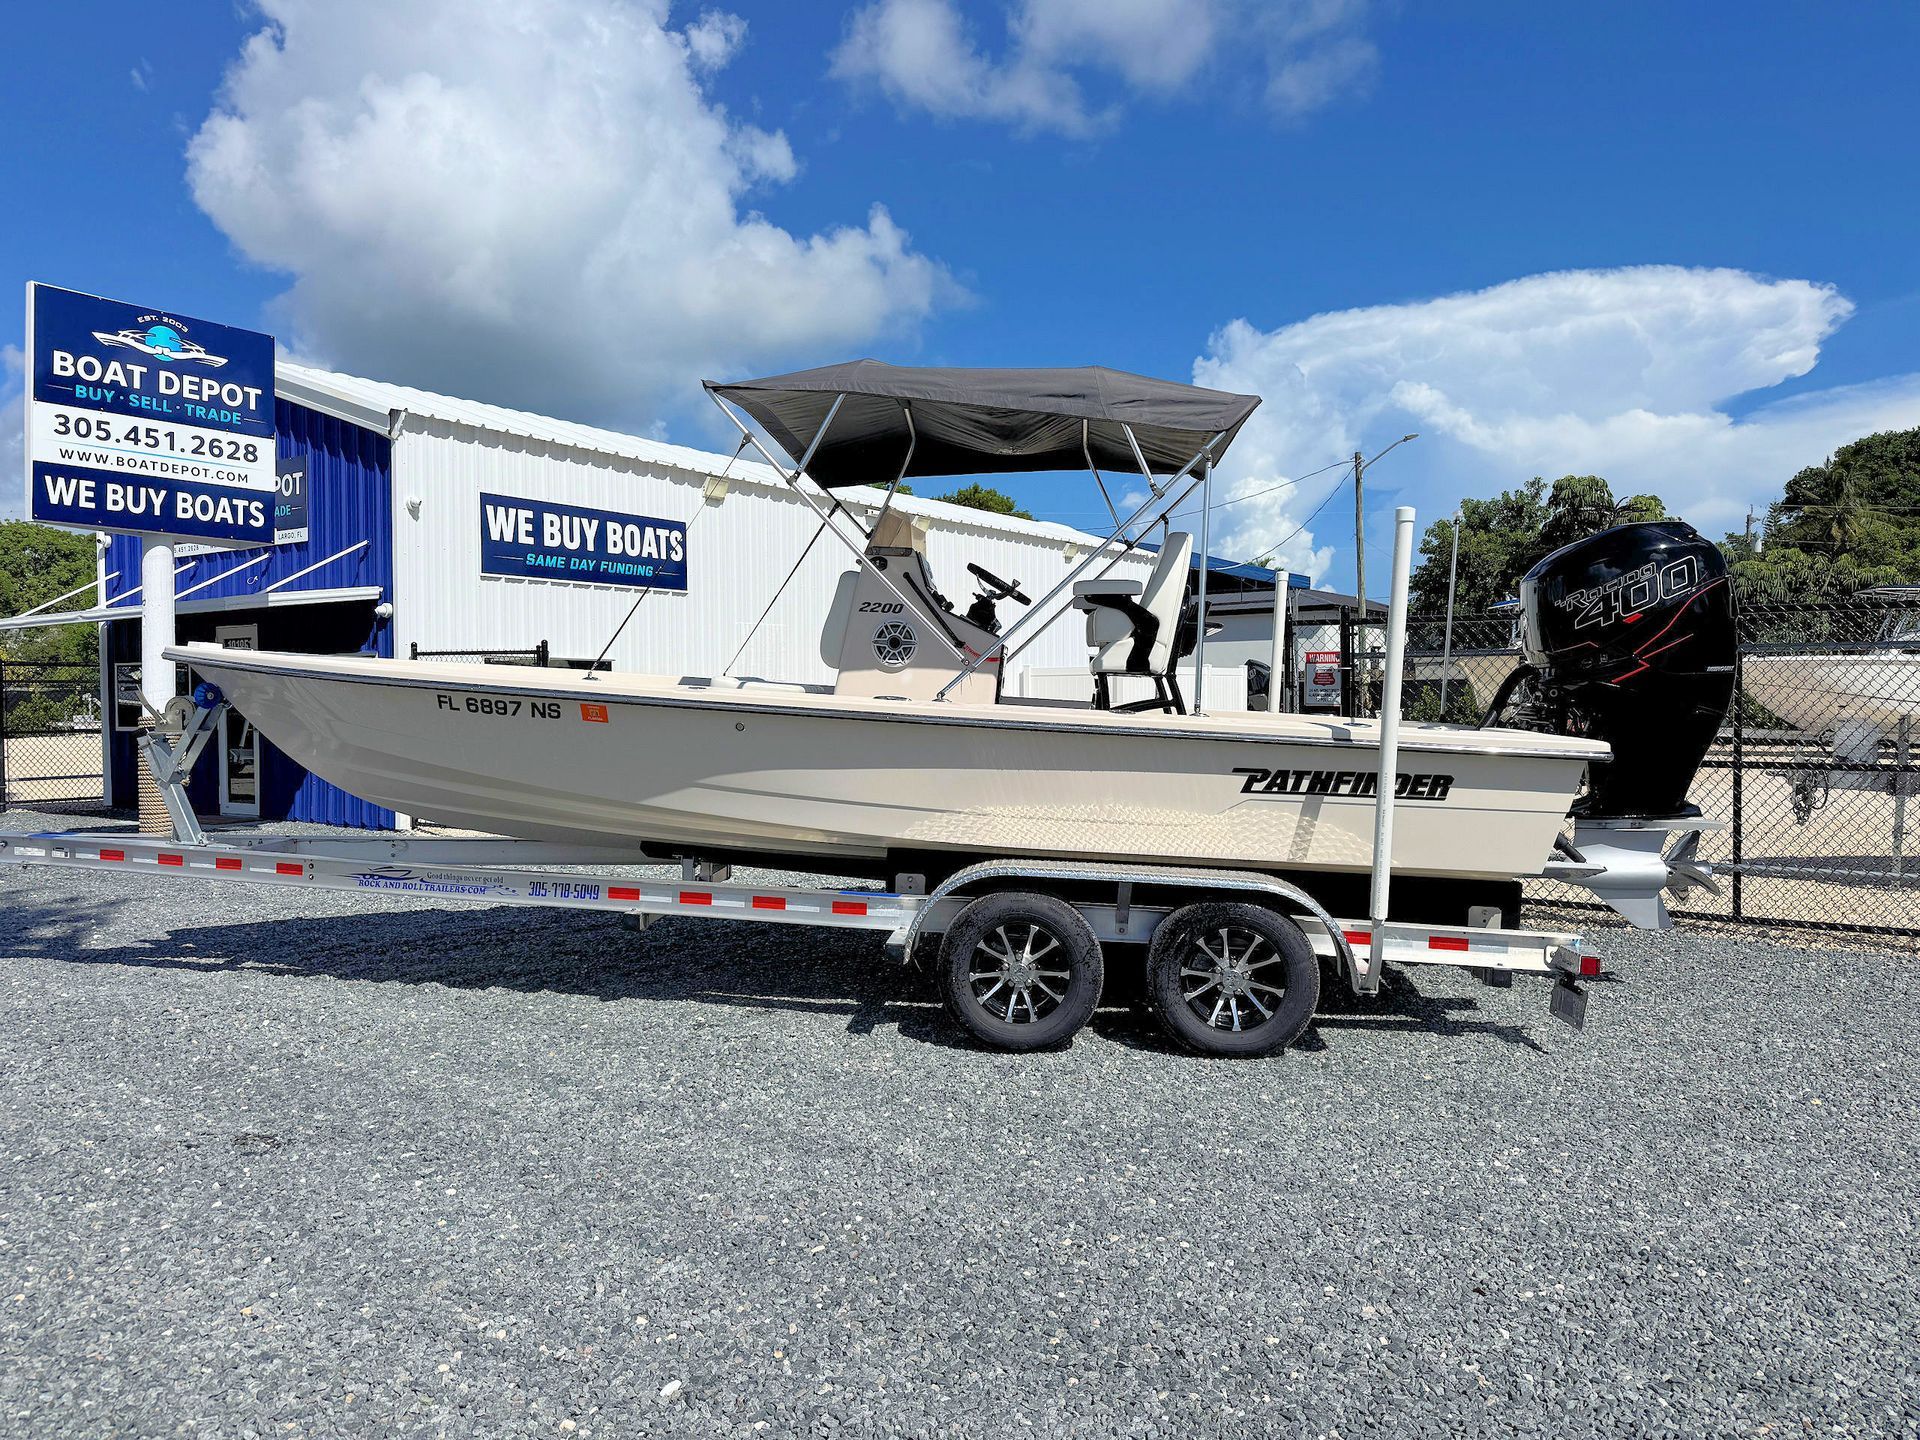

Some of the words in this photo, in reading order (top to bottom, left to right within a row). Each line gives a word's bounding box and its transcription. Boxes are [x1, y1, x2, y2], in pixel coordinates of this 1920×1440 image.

[136, 315, 159, 323] EST.
[162, 316, 189, 333] 2003
[52, 349, 148, 390] BOAT
[158, 370, 262, 411] DEPOT
[75, 384, 116, 403] BUY
[128, 394, 173, 413] SELL
[184, 403, 242, 425] TRADE
[53, 413, 259, 463] 305.451.2628
[59, 448, 249, 483] WWW.BOATDEPOT.COM
[275, 471, 304, 497] POT
[44, 475, 96, 509] WE
[106, 482, 168, 517] BUY
[176, 491, 266, 528] BOATS
[485, 504, 535, 546] WE
[543, 512, 600, 552] BUY
[606, 521, 684, 562] BOATS
[526, 553, 566, 569] SAME
[570, 560, 597, 572] DAY
[600, 561, 654, 578] FUNDING
[1565, 562, 1657, 612] Racing
[1574, 555, 1698, 630] 400
[858, 601, 904, 614] 2200
[437, 694, 461, 711] FL
[465, 697, 522, 717] 6897
[531, 702, 562, 720] NS
[359, 880, 381, 888] ROCK
[382, 881, 401, 889] AND
[426, 872, 443, 880] Good
[528, 881, 600, 900] 305-778-5049
